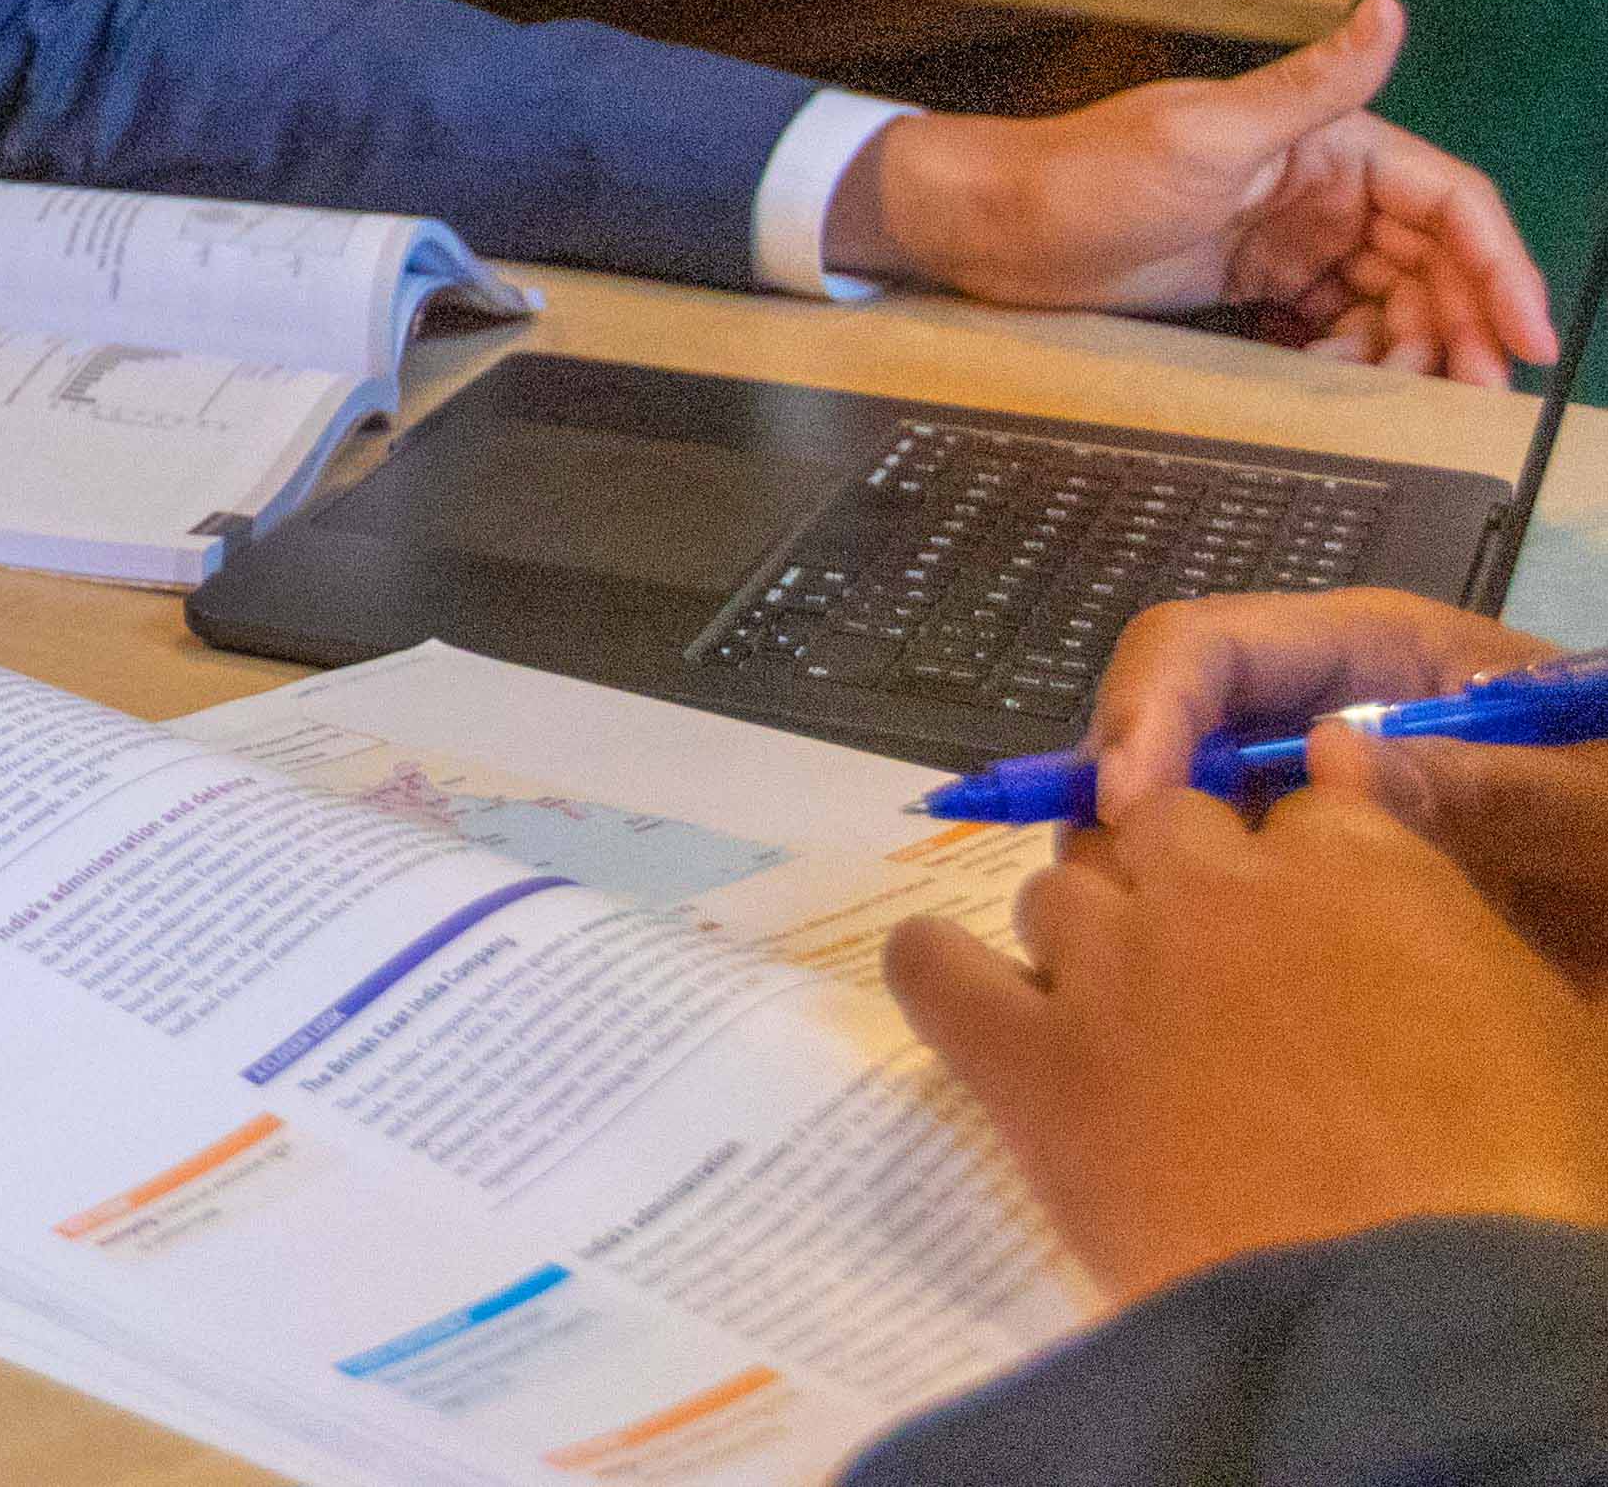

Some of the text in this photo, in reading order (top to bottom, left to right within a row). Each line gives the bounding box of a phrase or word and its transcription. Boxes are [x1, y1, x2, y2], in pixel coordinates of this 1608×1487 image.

[19, 758, 61, 782] British
[50, 822, 163, 902] administration
[162, 801, 196, 824] and
[192, 776, 257, 806] defence
[101, 882, 117, 898] of
[112, 858, 155, 887] British
[41, 951, 63, 967] the
[59, 923, 102, 953] British
[97, 903, 127, 924] East
[123, 881, 159, 905] India
[91, 928, 130, 958] added
[125, 919, 143, 932] to
[138, 905, 162, 921] the
[157, 877, 200, 907] British
[101, 986, 125, 1002] the
[122, 958, 164, 987] Indian
[149, 912, 225, 962] population
[223, 895, 248, 913] was
[153, 965, 189, 994] either
[186, 933, 234, 968] directly
[232, 907, 266, 934] under
[262, 880, 305, 909] British
[186, 975, 214, 993] The
[250, 897, 334, 951] government
[196, 996, 221, 1018] and
[216, 983, 241, 1000] the
[256, 919, 323, 961] stationed
[299, 937, 517, 1093] The British East India Company
[267, 1035, 310, 1070] CLOSER
[309, 1006, 343, 1036] LOOK
